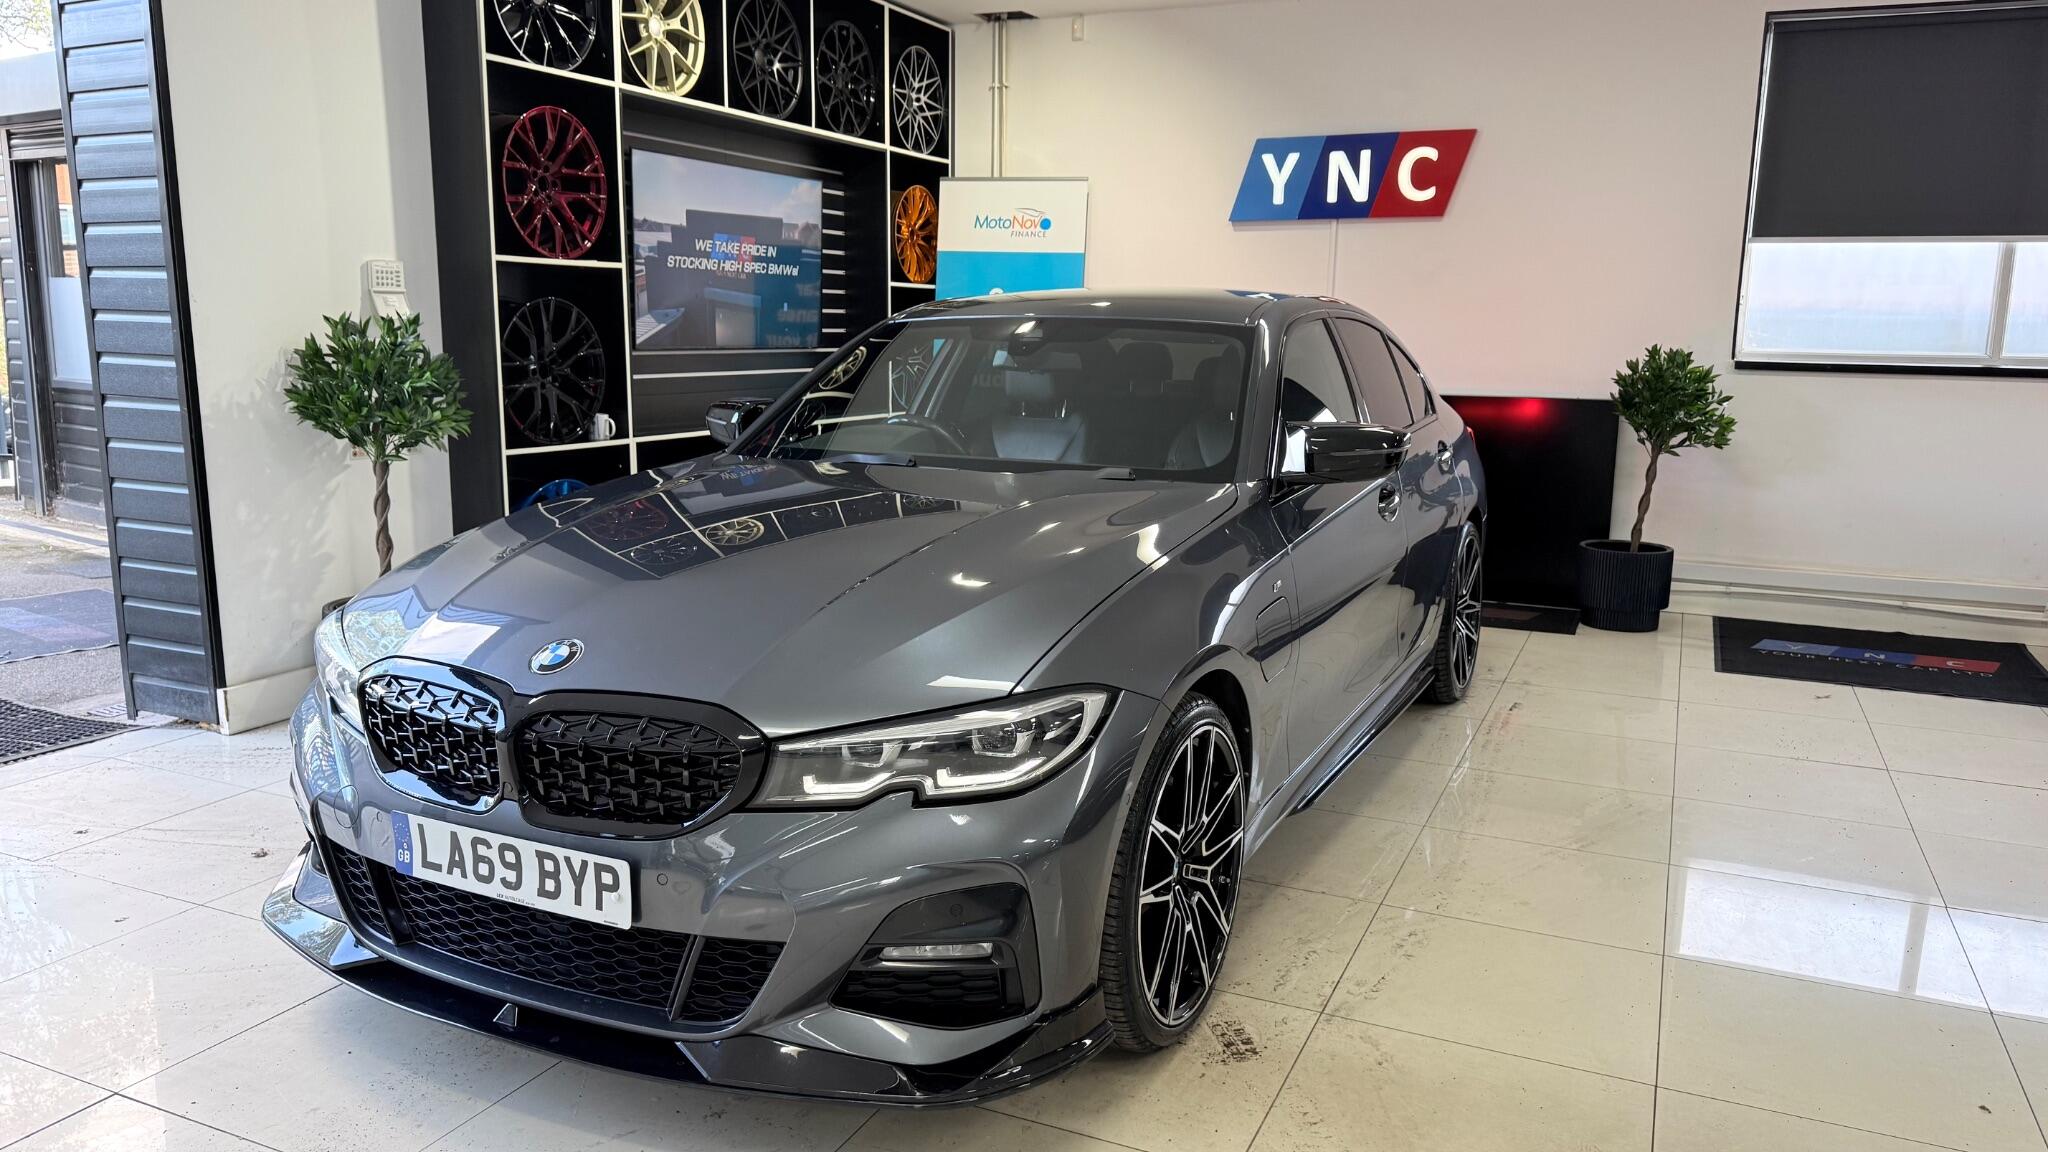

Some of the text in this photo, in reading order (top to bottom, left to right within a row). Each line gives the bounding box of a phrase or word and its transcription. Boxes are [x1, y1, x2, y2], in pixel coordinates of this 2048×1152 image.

[1261, 145, 1439, 206] YNC
[974, 214, 1052, 232] MotoNovo
[1010, 230, 1048, 238] FINANCE
[695, 239, 777, 258] WE TAKE PRIDE IN
[667, 255, 718, 271] STOCKING
[719, 259, 743, 273] HIGH
[743, 261, 767, 274] SPEC
[1760, 650, 1815, 659] YOUR
[1827, 656, 1884, 666] NEXT
[1895, 664, 1938, 672] CAR
[398, 849, 410, 863] GB
[417, 823, 620, 912] LA69 BYP
